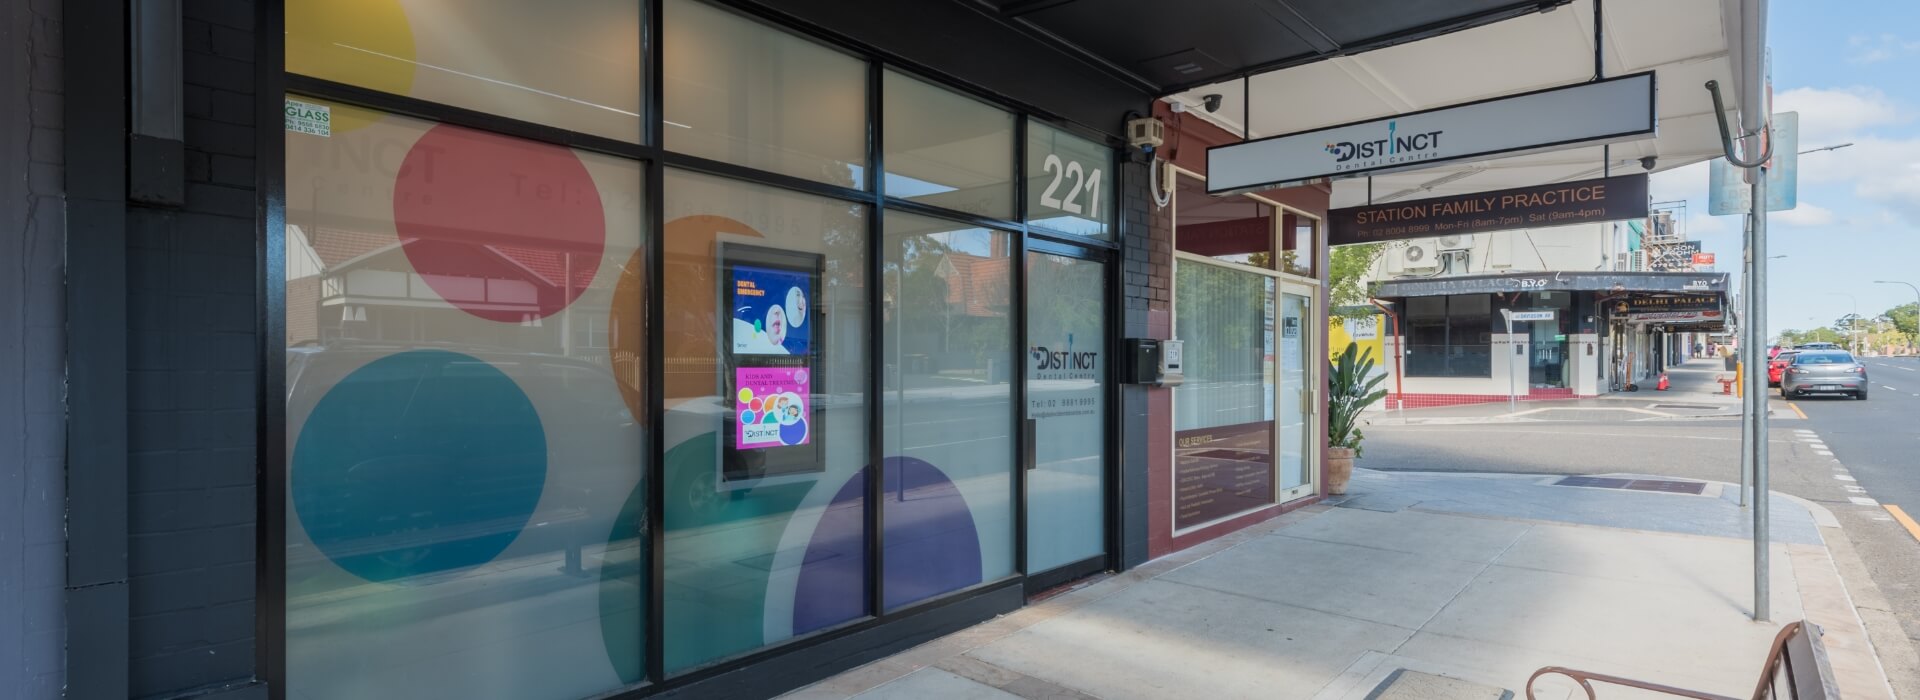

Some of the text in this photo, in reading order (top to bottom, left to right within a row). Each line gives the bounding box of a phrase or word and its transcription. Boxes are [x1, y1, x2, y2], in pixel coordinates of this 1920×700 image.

[286, 106, 329, 122] GLASS
[1336, 122, 1443, 162] DISTINCT
[1336, 151, 1438, 171] Dental Centre
[1040, 154, 1101, 218] 221
[1357, 185, 1606, 225] STATION FAMILY PRACTICE
[1529, 213, 1546, 222] Sat
[1548, 207, 1606, 222] (9am-4pm)
[1037, 338, 1097, 370] DISTINCT
